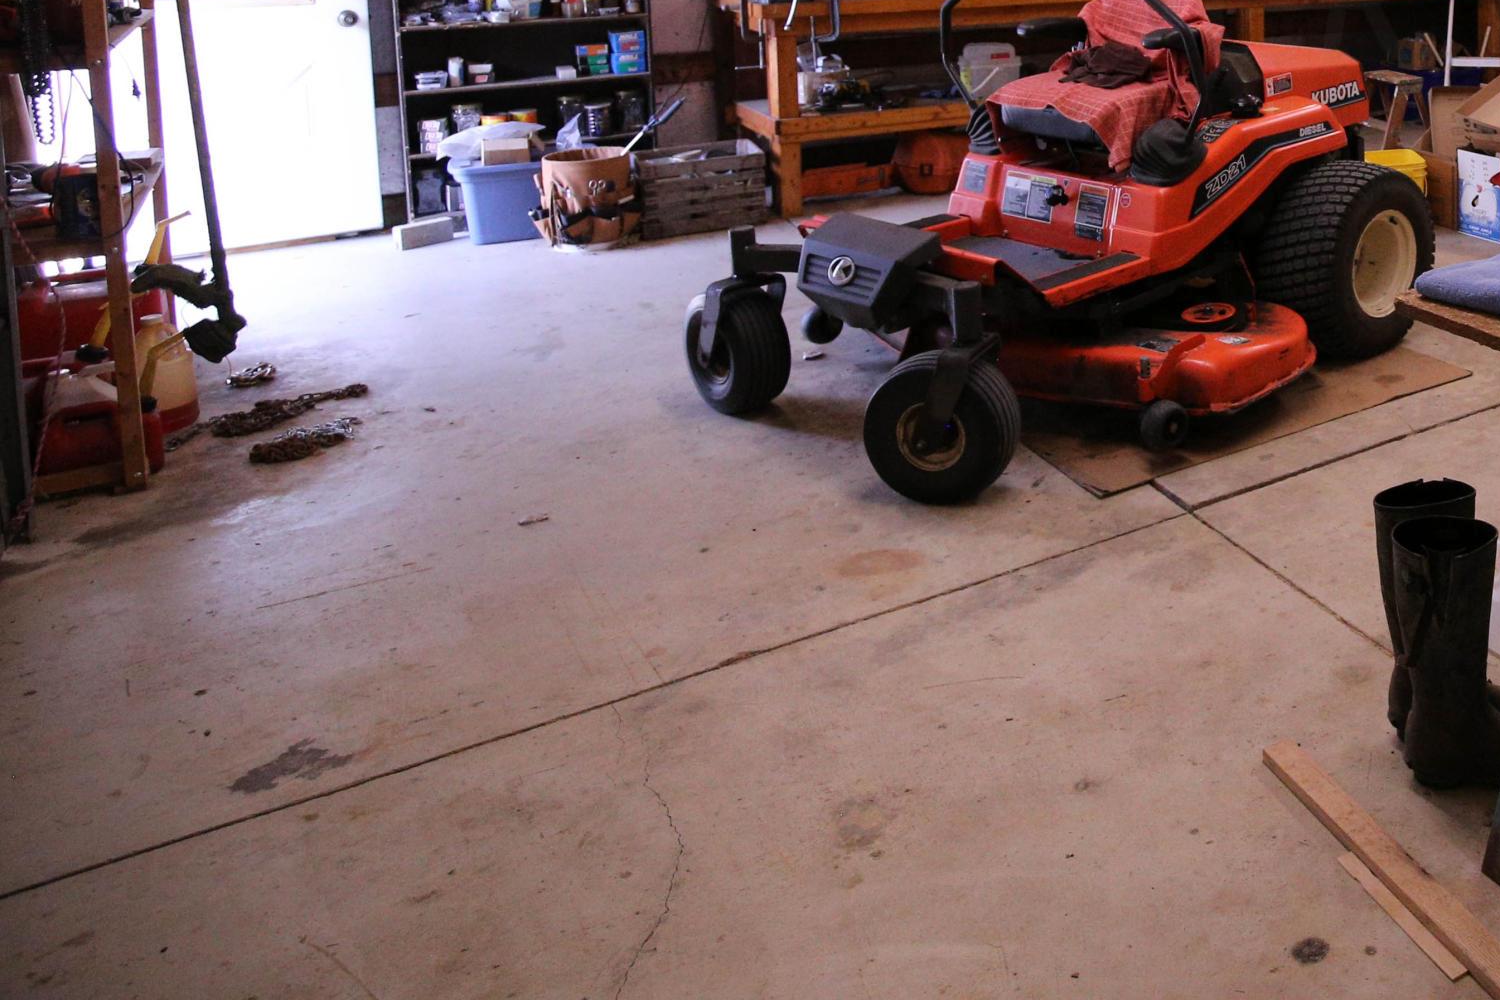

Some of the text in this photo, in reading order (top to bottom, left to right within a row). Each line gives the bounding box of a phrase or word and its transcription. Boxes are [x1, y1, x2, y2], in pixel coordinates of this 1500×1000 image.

[1312, 81, 1360, 105] KUBOTA
[1299, 122, 1327, 137] DIESEL
[1205, 153, 1247, 199] ZD21
